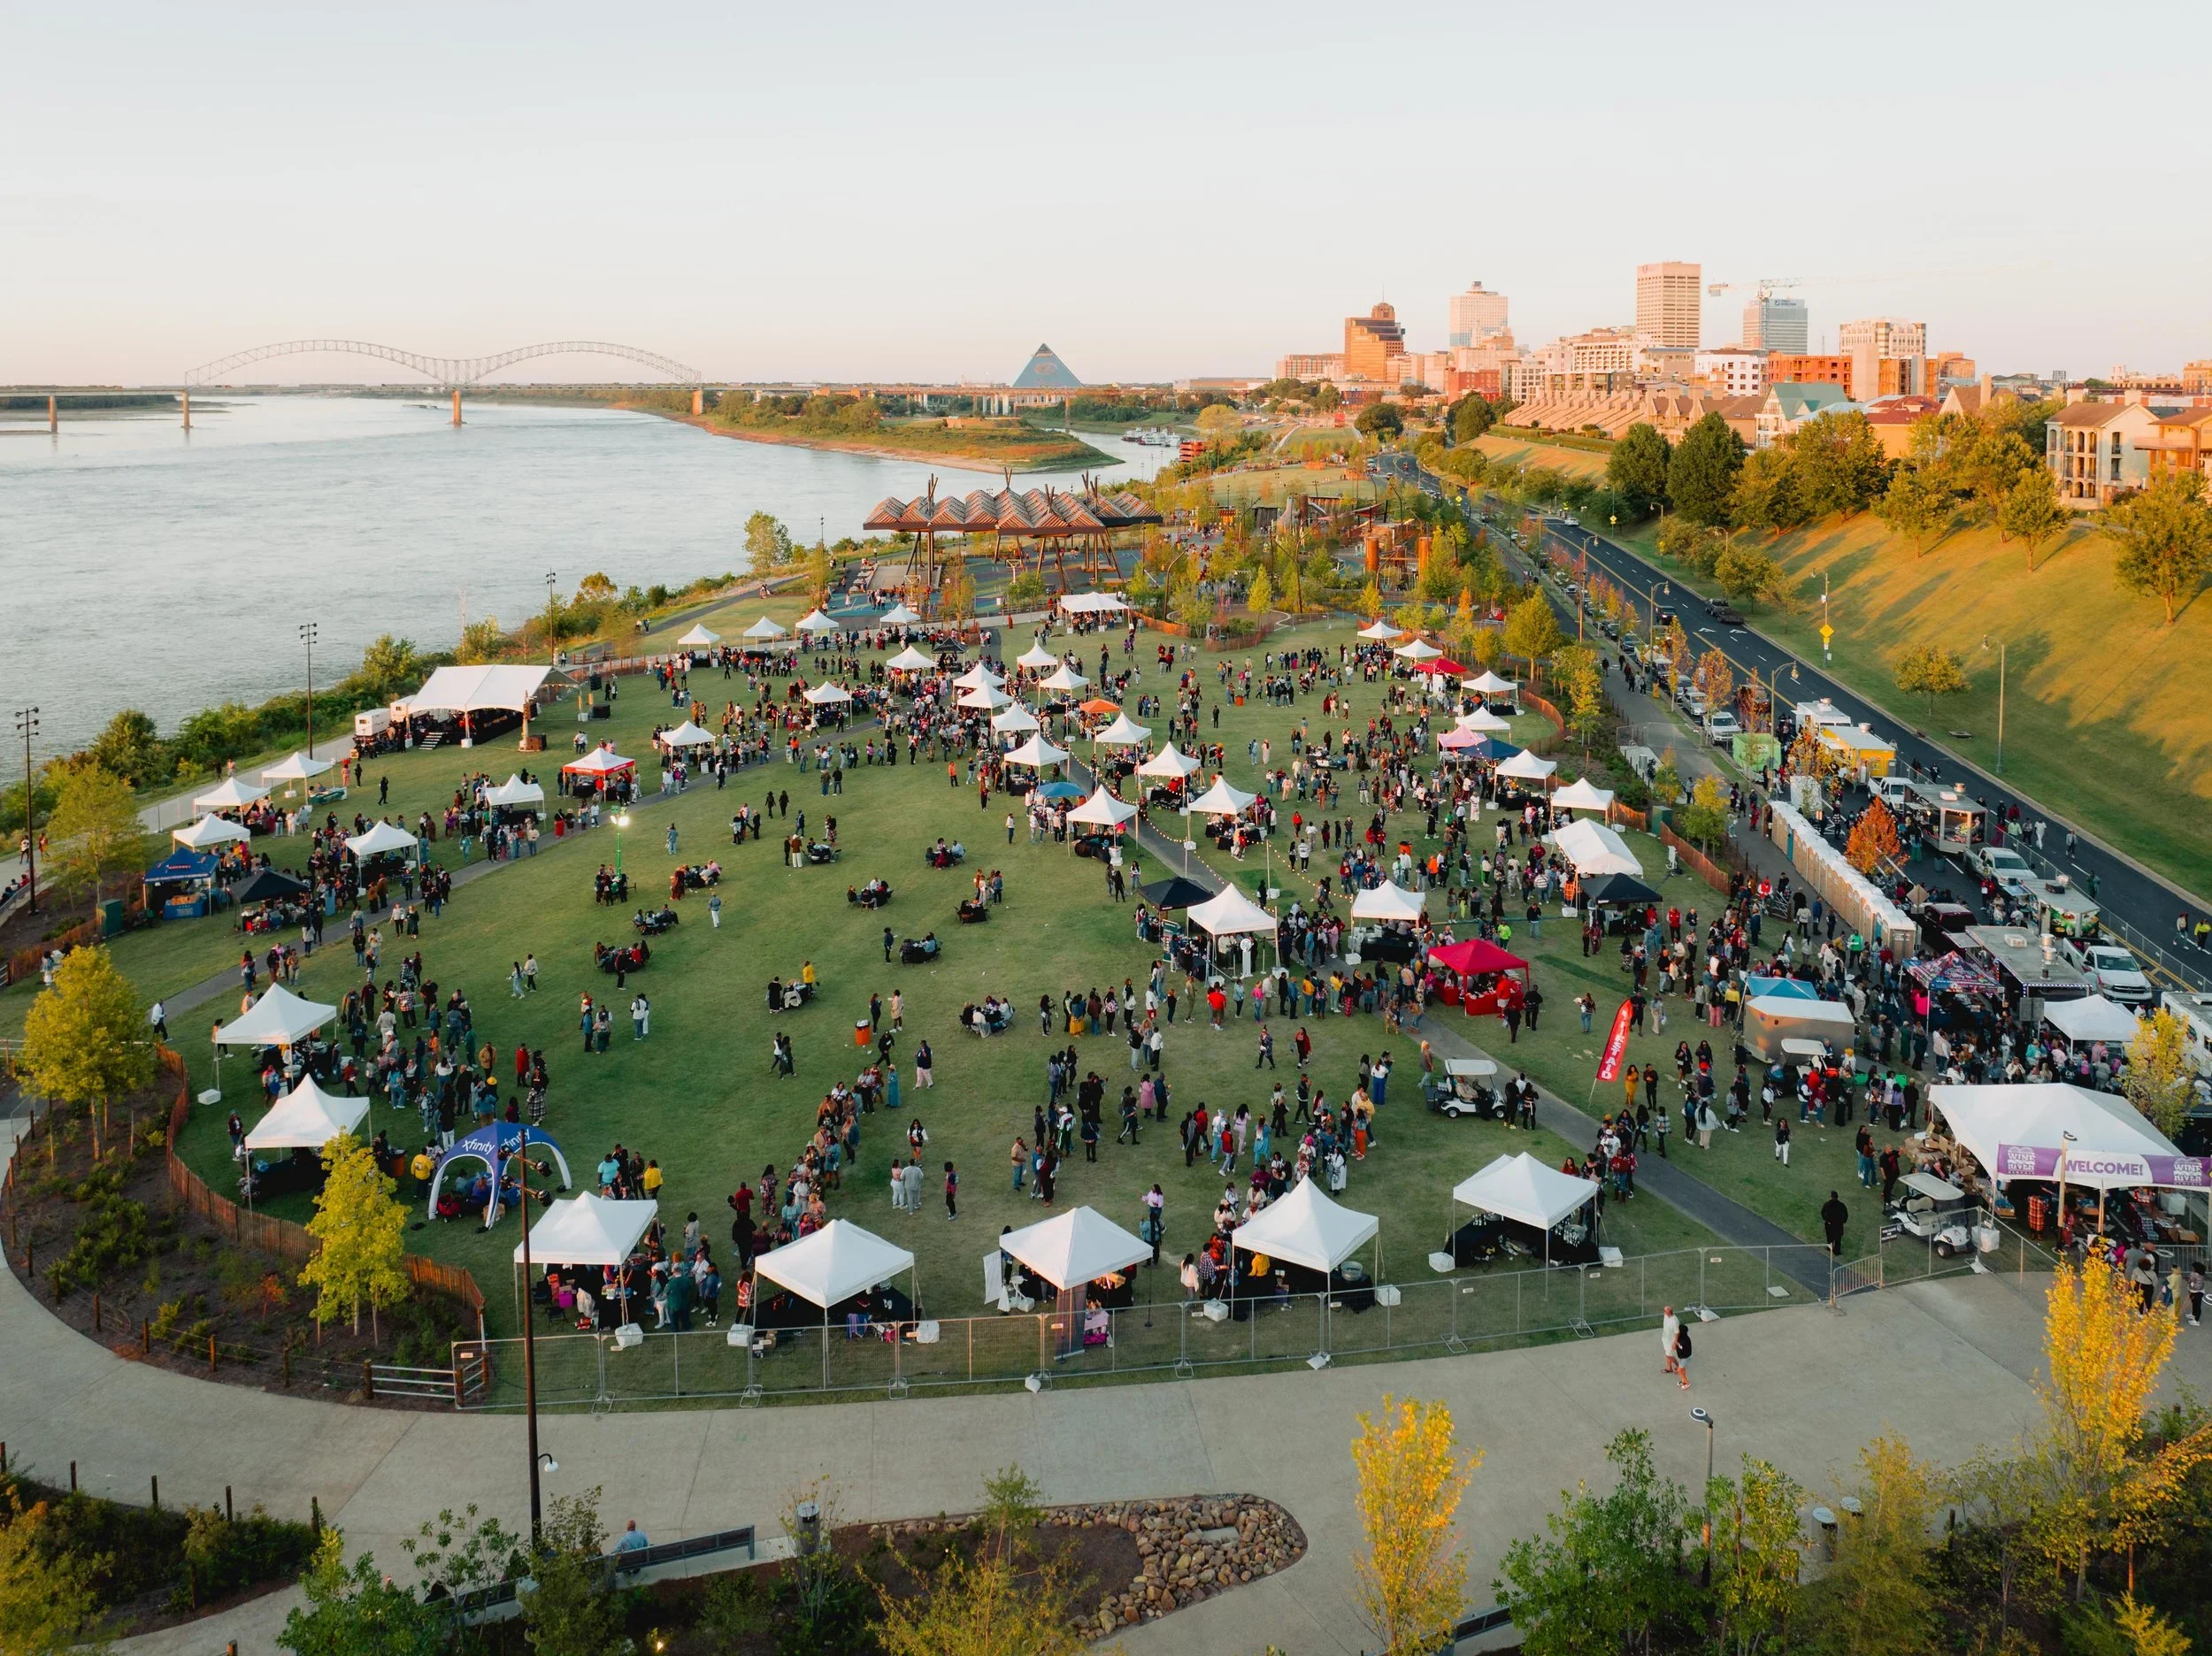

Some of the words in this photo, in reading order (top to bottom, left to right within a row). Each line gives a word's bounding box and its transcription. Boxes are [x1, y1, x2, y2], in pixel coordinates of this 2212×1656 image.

[1601, 1056, 1617, 1080] AID
[461, 1138, 495, 1155] xfinity
[501, 1128, 531, 1148] finiy
[2007, 1153, 2036, 1162] WINE
[2064, 1159, 2144, 1177] WELCOME!
[2173, 1163, 2203, 1173] WINE
